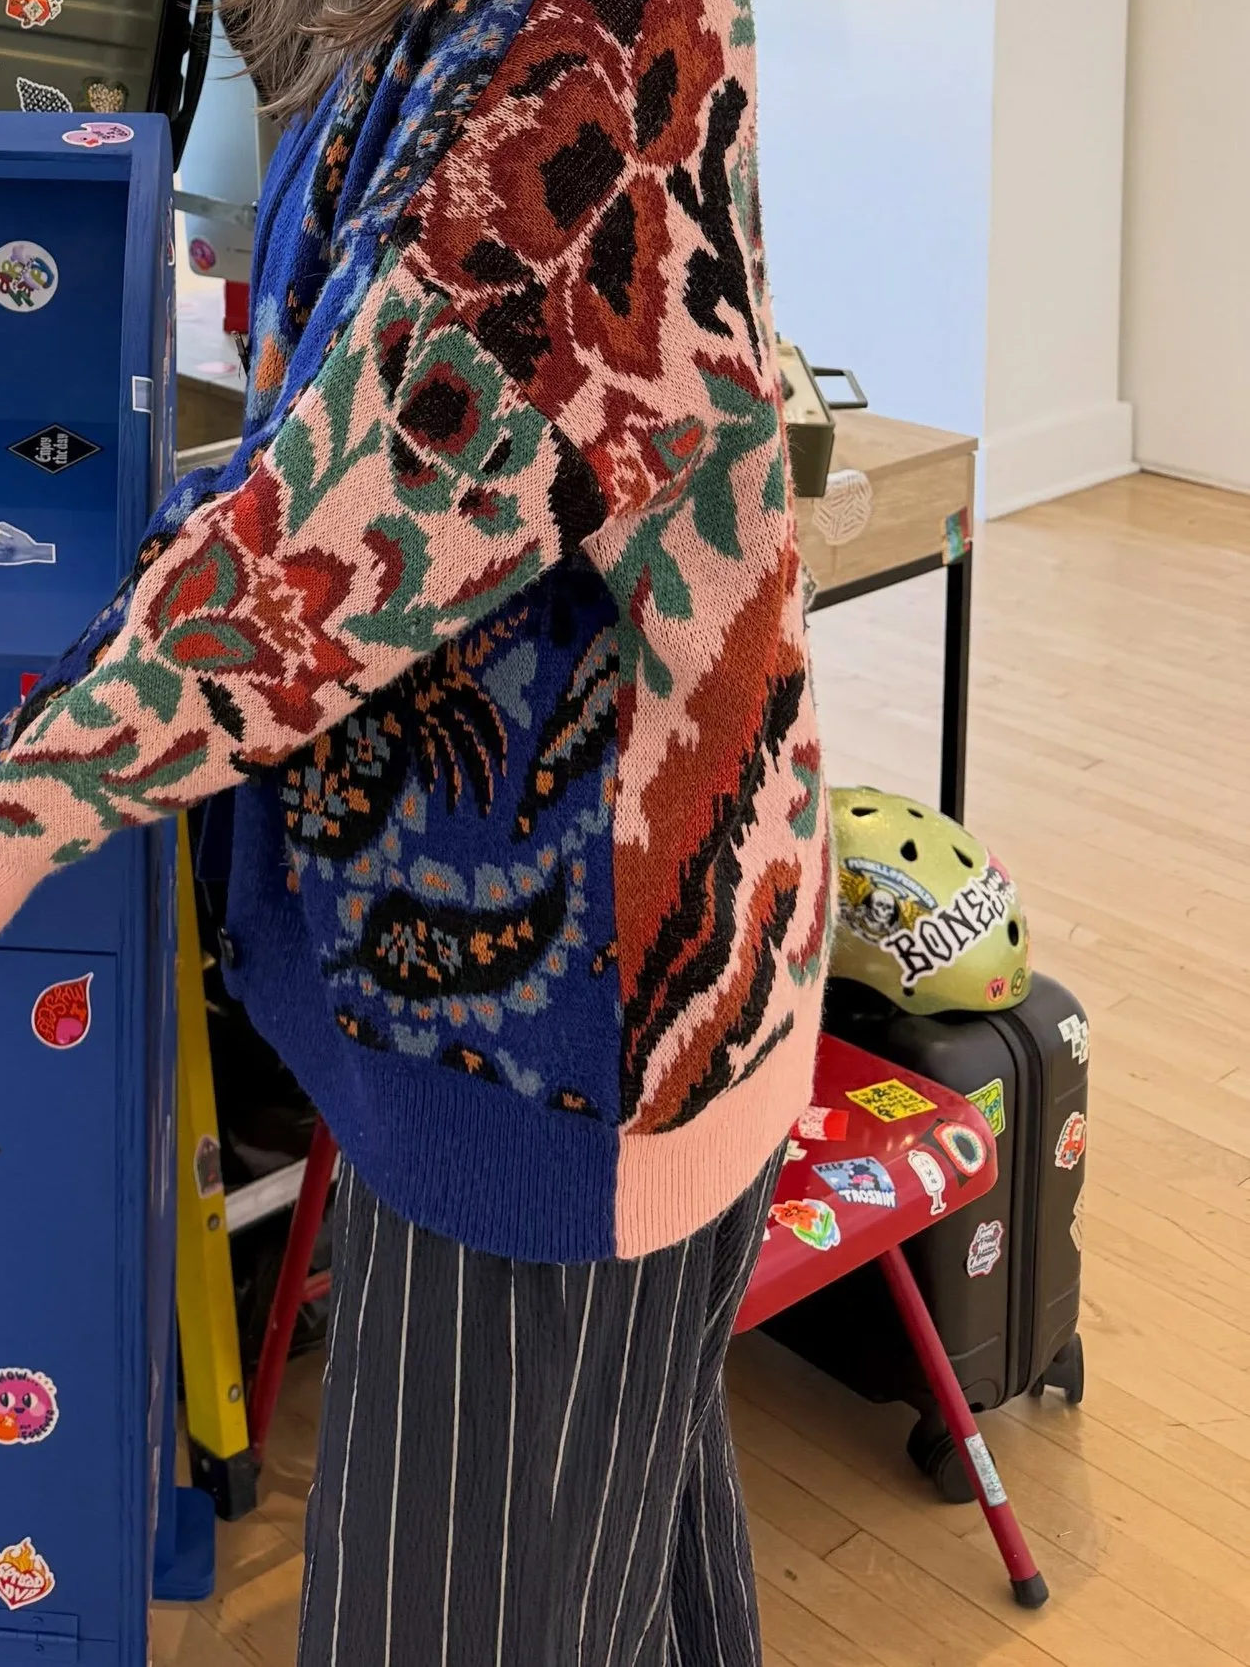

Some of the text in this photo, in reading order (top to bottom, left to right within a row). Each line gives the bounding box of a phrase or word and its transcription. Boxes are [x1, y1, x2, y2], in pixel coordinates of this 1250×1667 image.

[34, 437, 55, 463] Enjoy
[52, 433, 69, 464] the day
